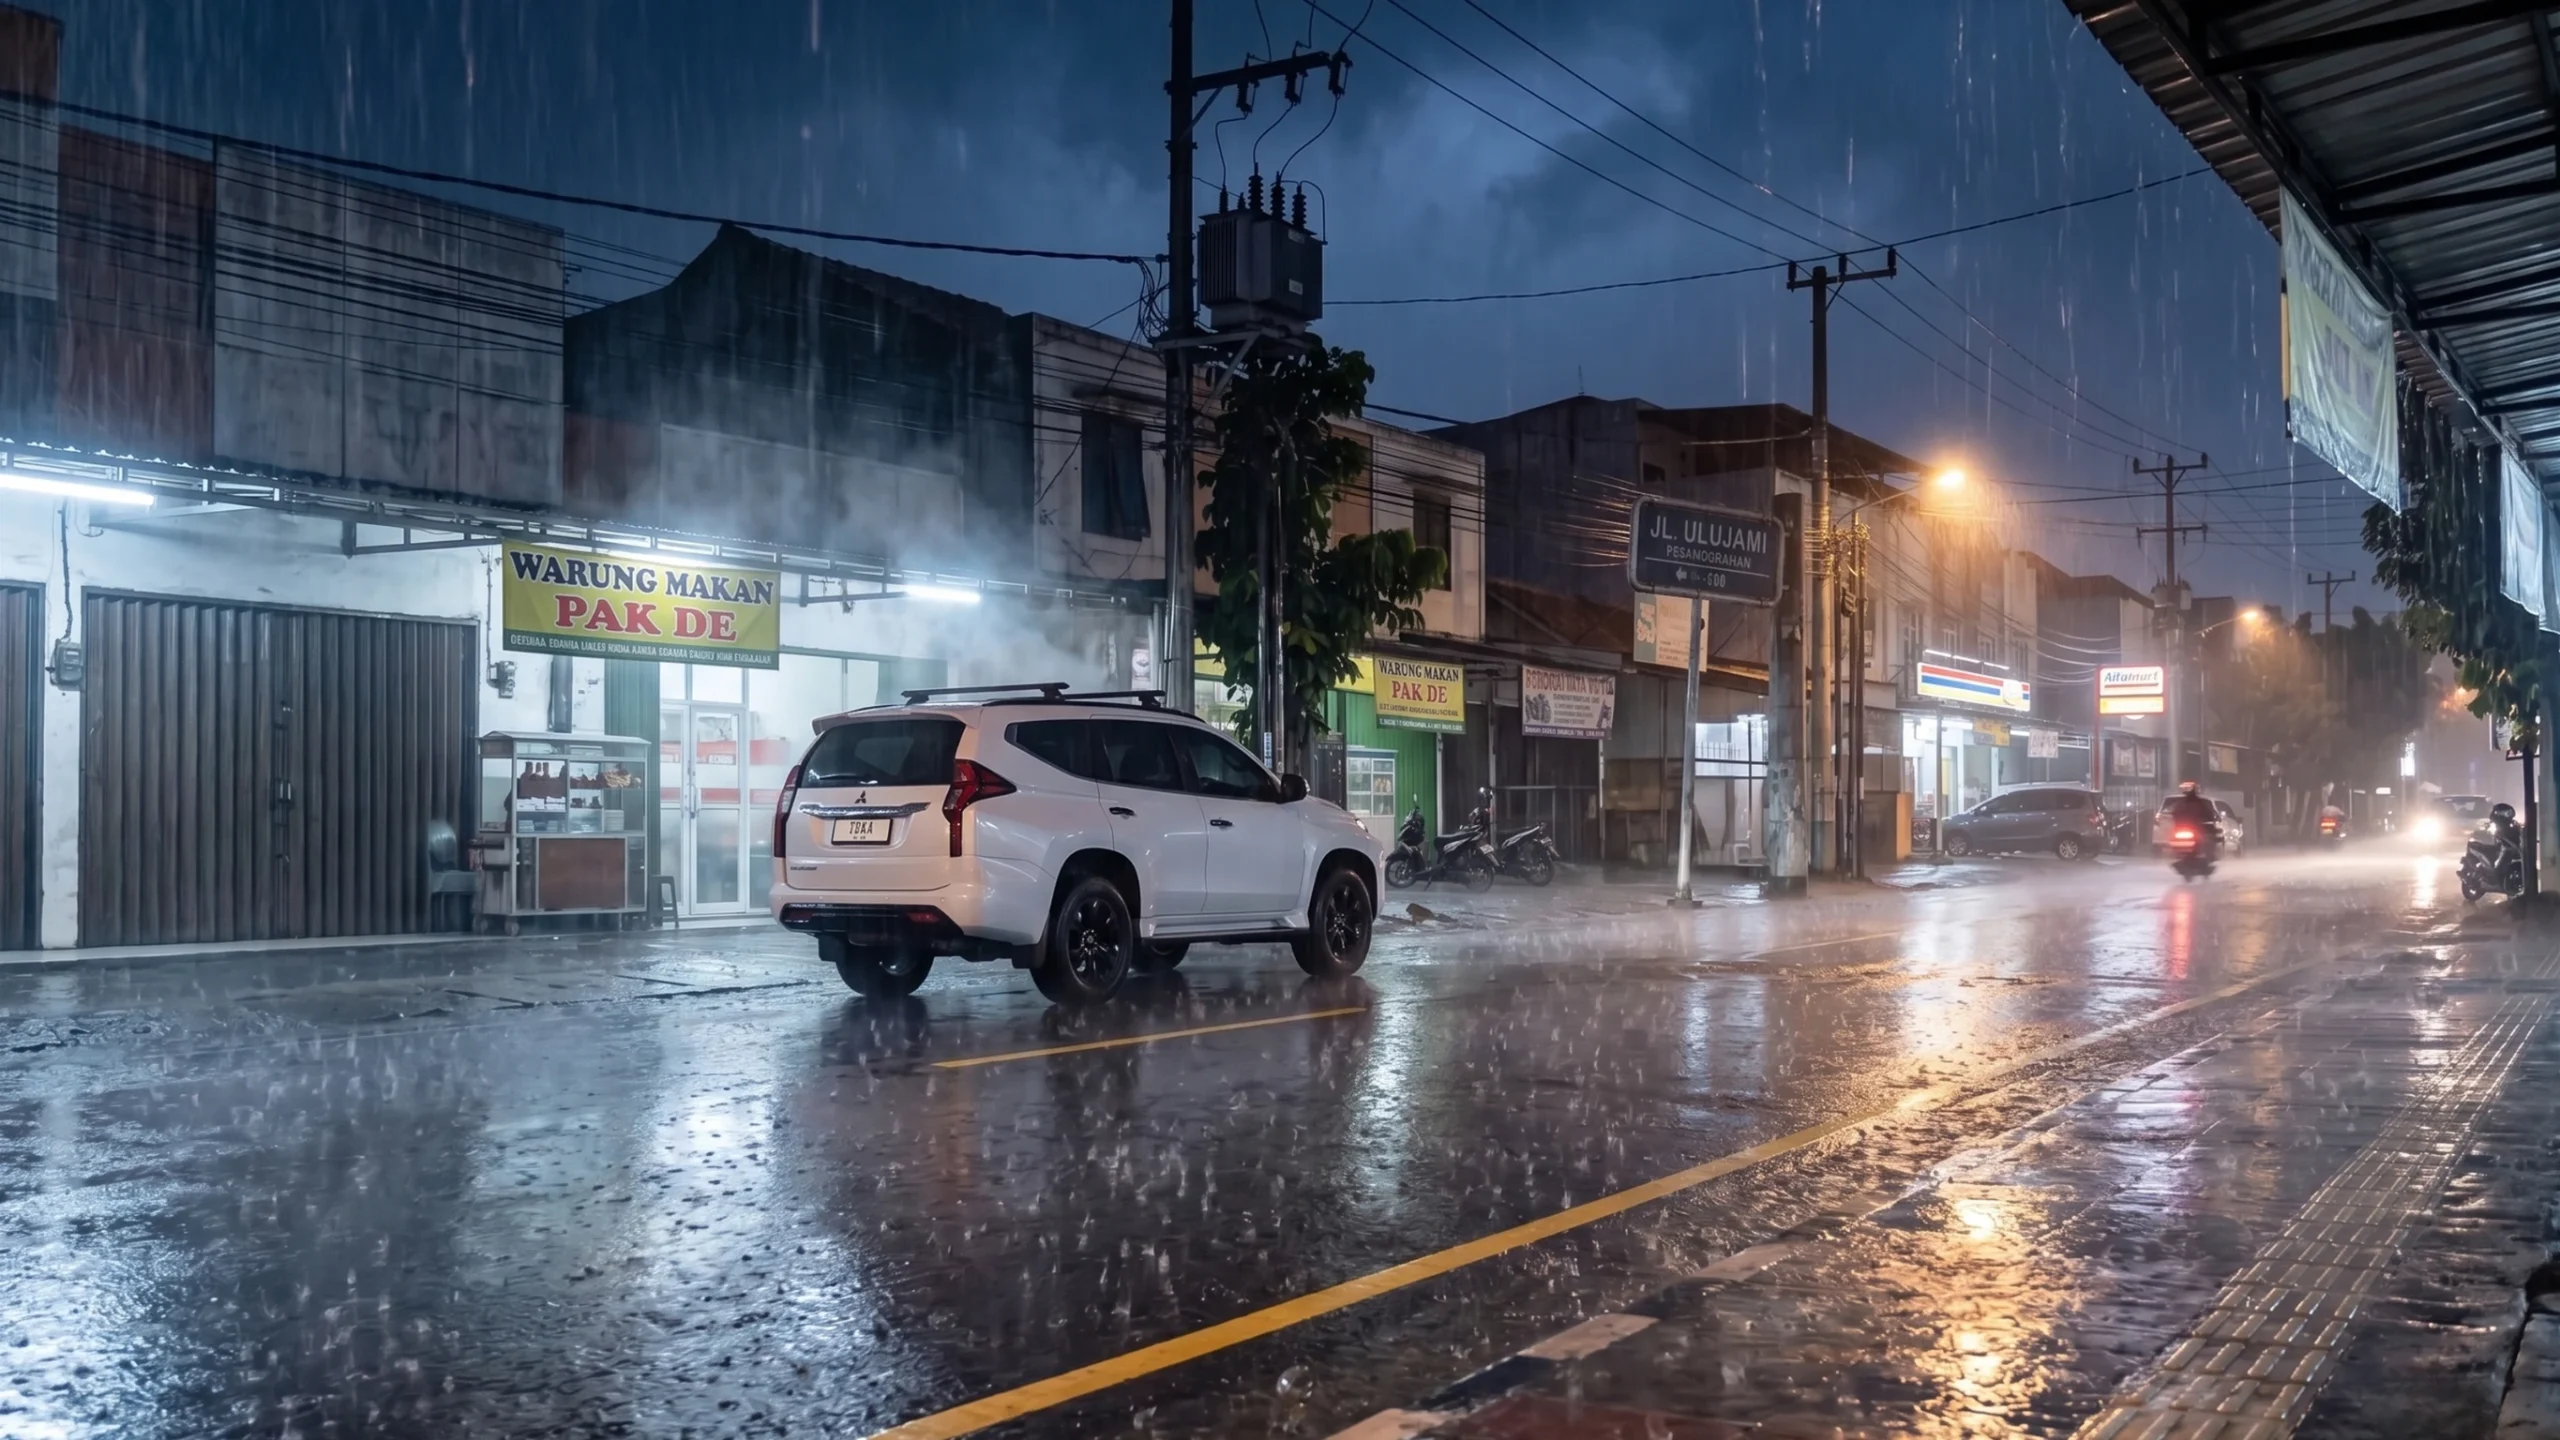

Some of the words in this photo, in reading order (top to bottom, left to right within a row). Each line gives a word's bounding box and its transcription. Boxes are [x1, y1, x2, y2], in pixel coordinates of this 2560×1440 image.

[1651, 515, 1678, 540] JL.
[1684, 520, 1767, 553] ULUJAMI
[509, 551, 658, 593] WARUNG
[665, 571, 774, 605] MAKAN
[555, 595, 661, 635] PAK
[674, 607, 737, 641] DE
[1378, 660, 1422, 678] WARUNG
[1424, 666, 1459, 682] MAKAN
[1392, 680, 1423, 701] PAK
[1427, 684, 1448, 703] DE
